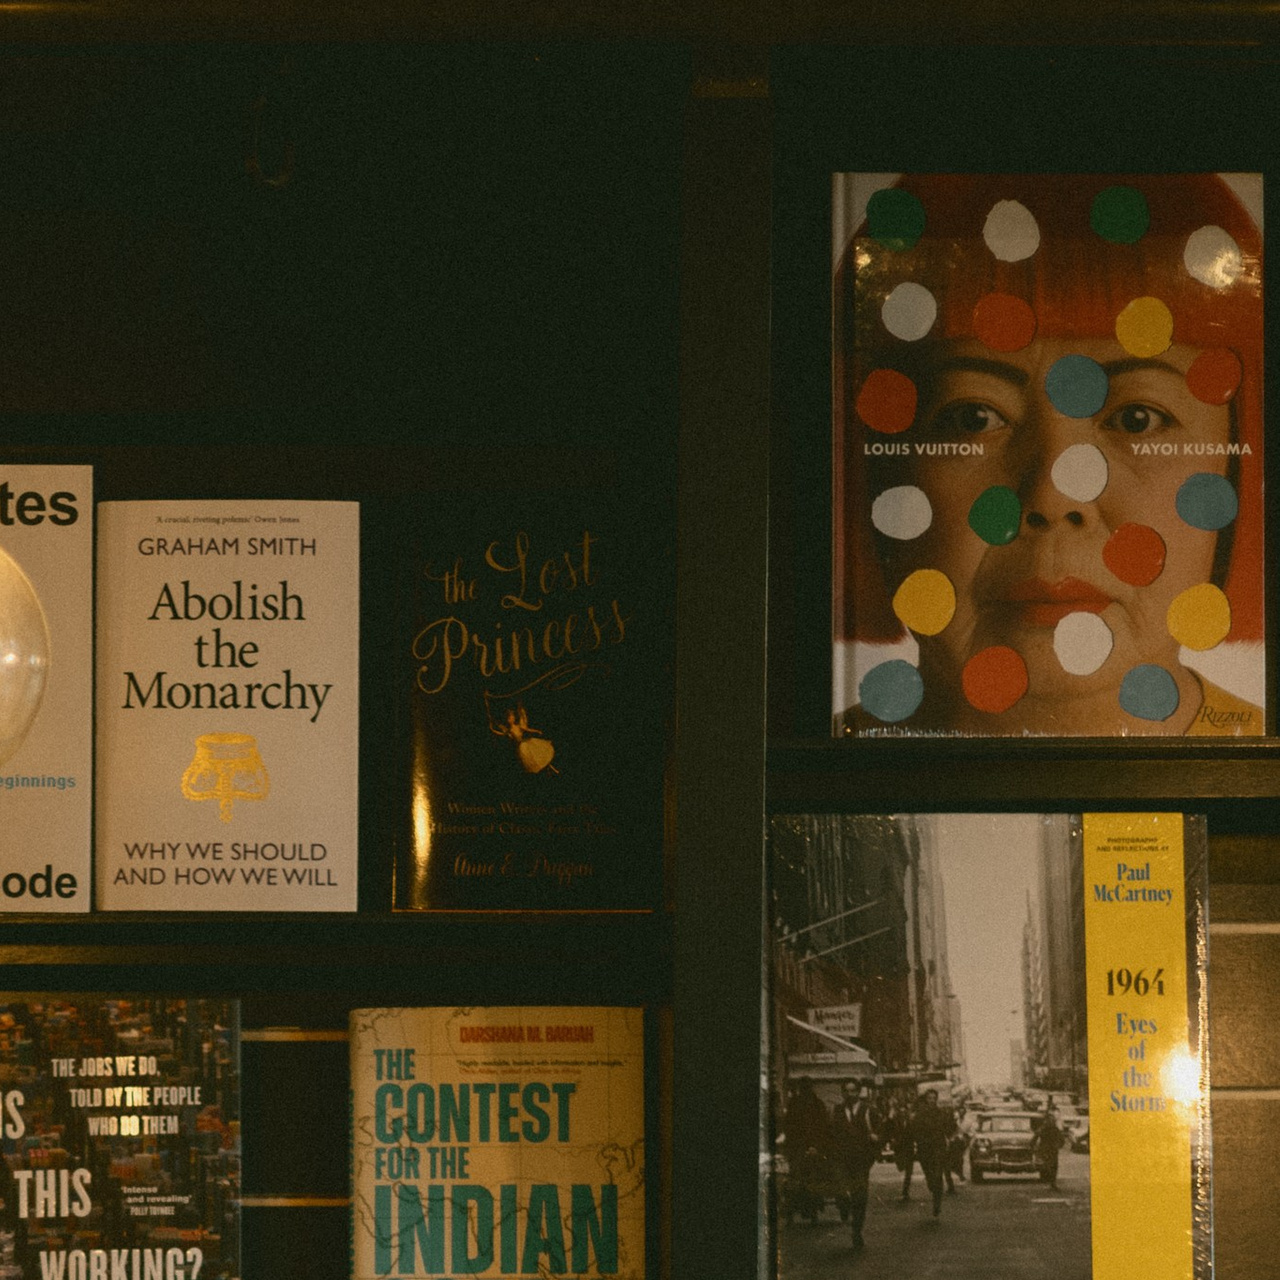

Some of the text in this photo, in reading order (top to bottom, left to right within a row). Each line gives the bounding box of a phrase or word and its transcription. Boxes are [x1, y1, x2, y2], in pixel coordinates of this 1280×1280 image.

[864, 443, 984, 456] LOUIS VUITTON
[1131, 443, 1251, 456] YAYOI KUSAMA
[138, 538, 316, 556] GRAHAM SMITH
[425, 529, 598, 610] the Lost
[148, 581, 306, 621] Abolish
[194, 629, 259, 668] the
[412, 600, 634, 694] Princess
[122, 670, 332, 723] Monarchy
[125, 843, 327, 861] WHY WE SHOULD
[114, 868, 337, 886] AND HOW WE WILL
[1117, 863, 1150, 881] Paul
[1094, 883, 1173, 906] McCartney
[1106, 969, 1165, 996] 1964
[1116, 1013, 1158, 1038] Eyes
[1128, 1038, 1146, 1060] of
[374, 1049, 415, 1080] THE
[1122, 1066, 1152, 1087] the
[375, 1083, 575, 1143] CONTEST
[1110, 1092, 1166, 1112] Storm
[374, 1148, 469, 1179] FOR THE
[14, 1168, 92, 1218] THIS
[374, 1185, 618, 1274] INDIAN
